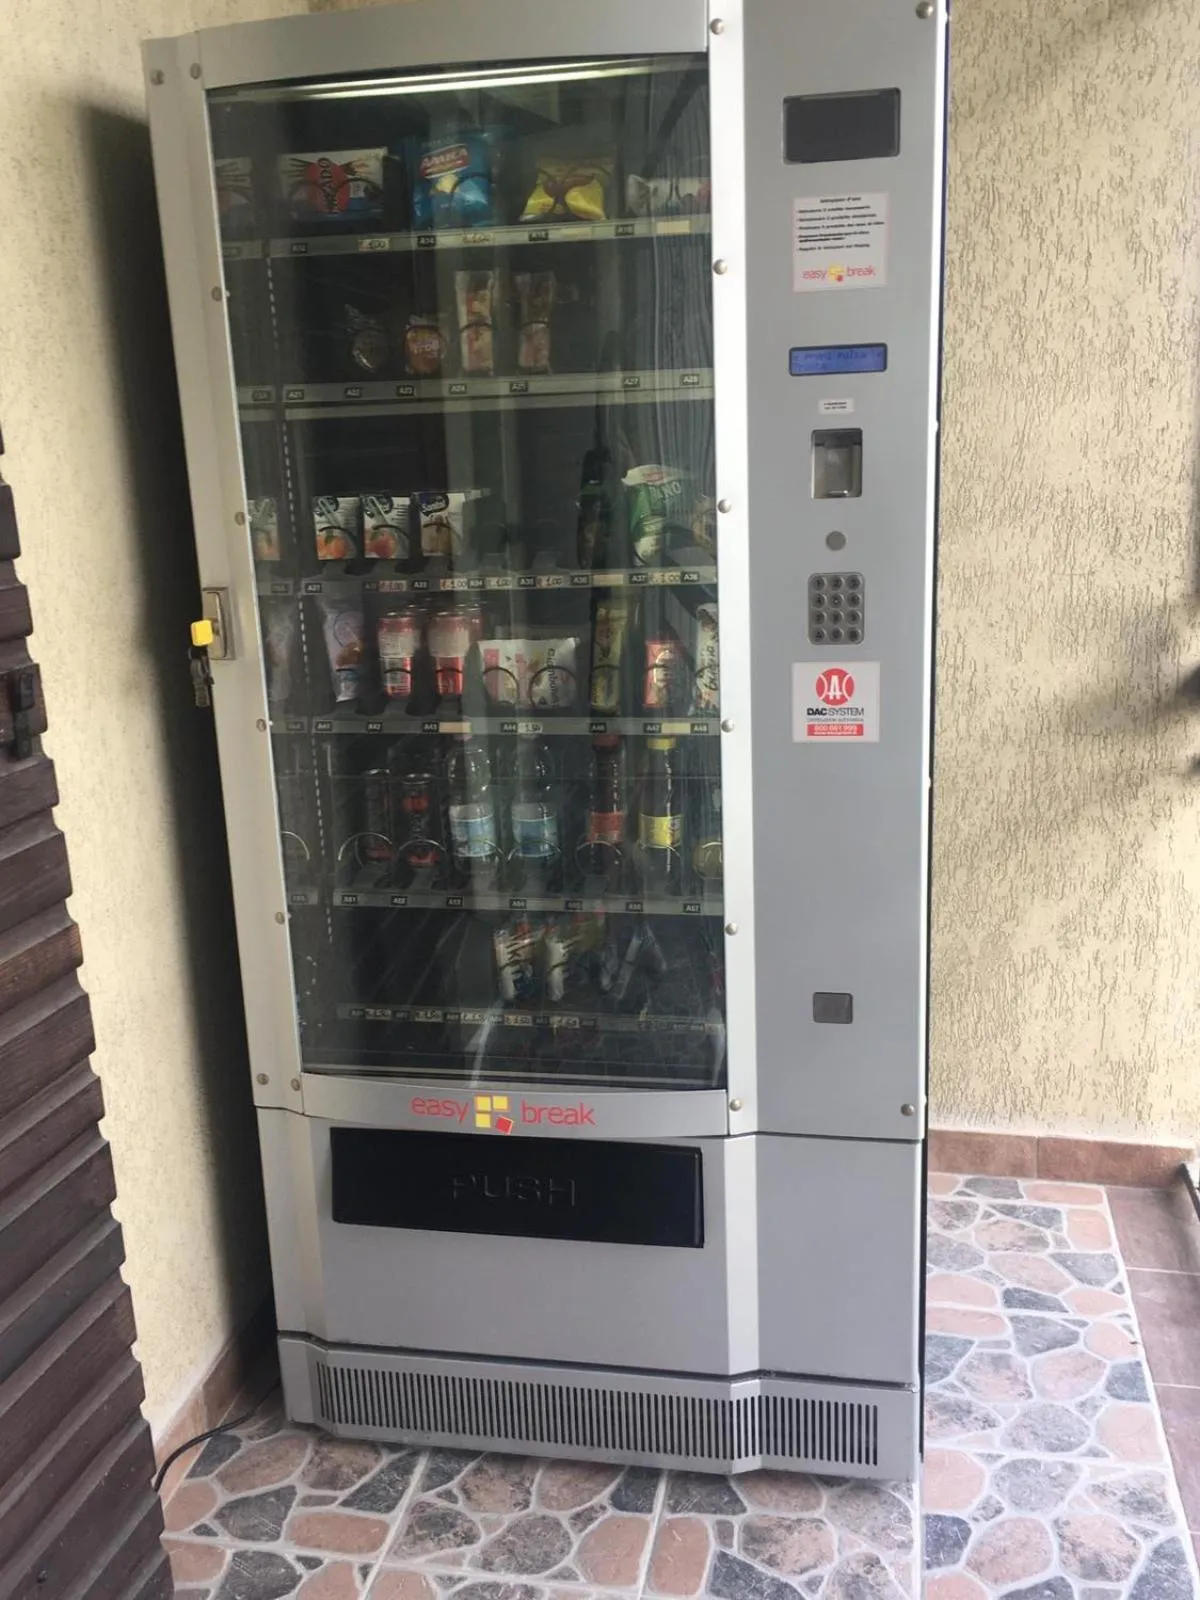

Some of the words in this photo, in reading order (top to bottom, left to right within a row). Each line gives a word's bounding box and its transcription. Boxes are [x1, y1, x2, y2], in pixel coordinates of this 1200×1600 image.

[802, 269, 828, 281] easy
[846, 265, 876, 277] break
[411, 1097, 469, 1124] easy
[521, 1100, 596, 1125] break
[452, 1172, 576, 1207] PUSH
